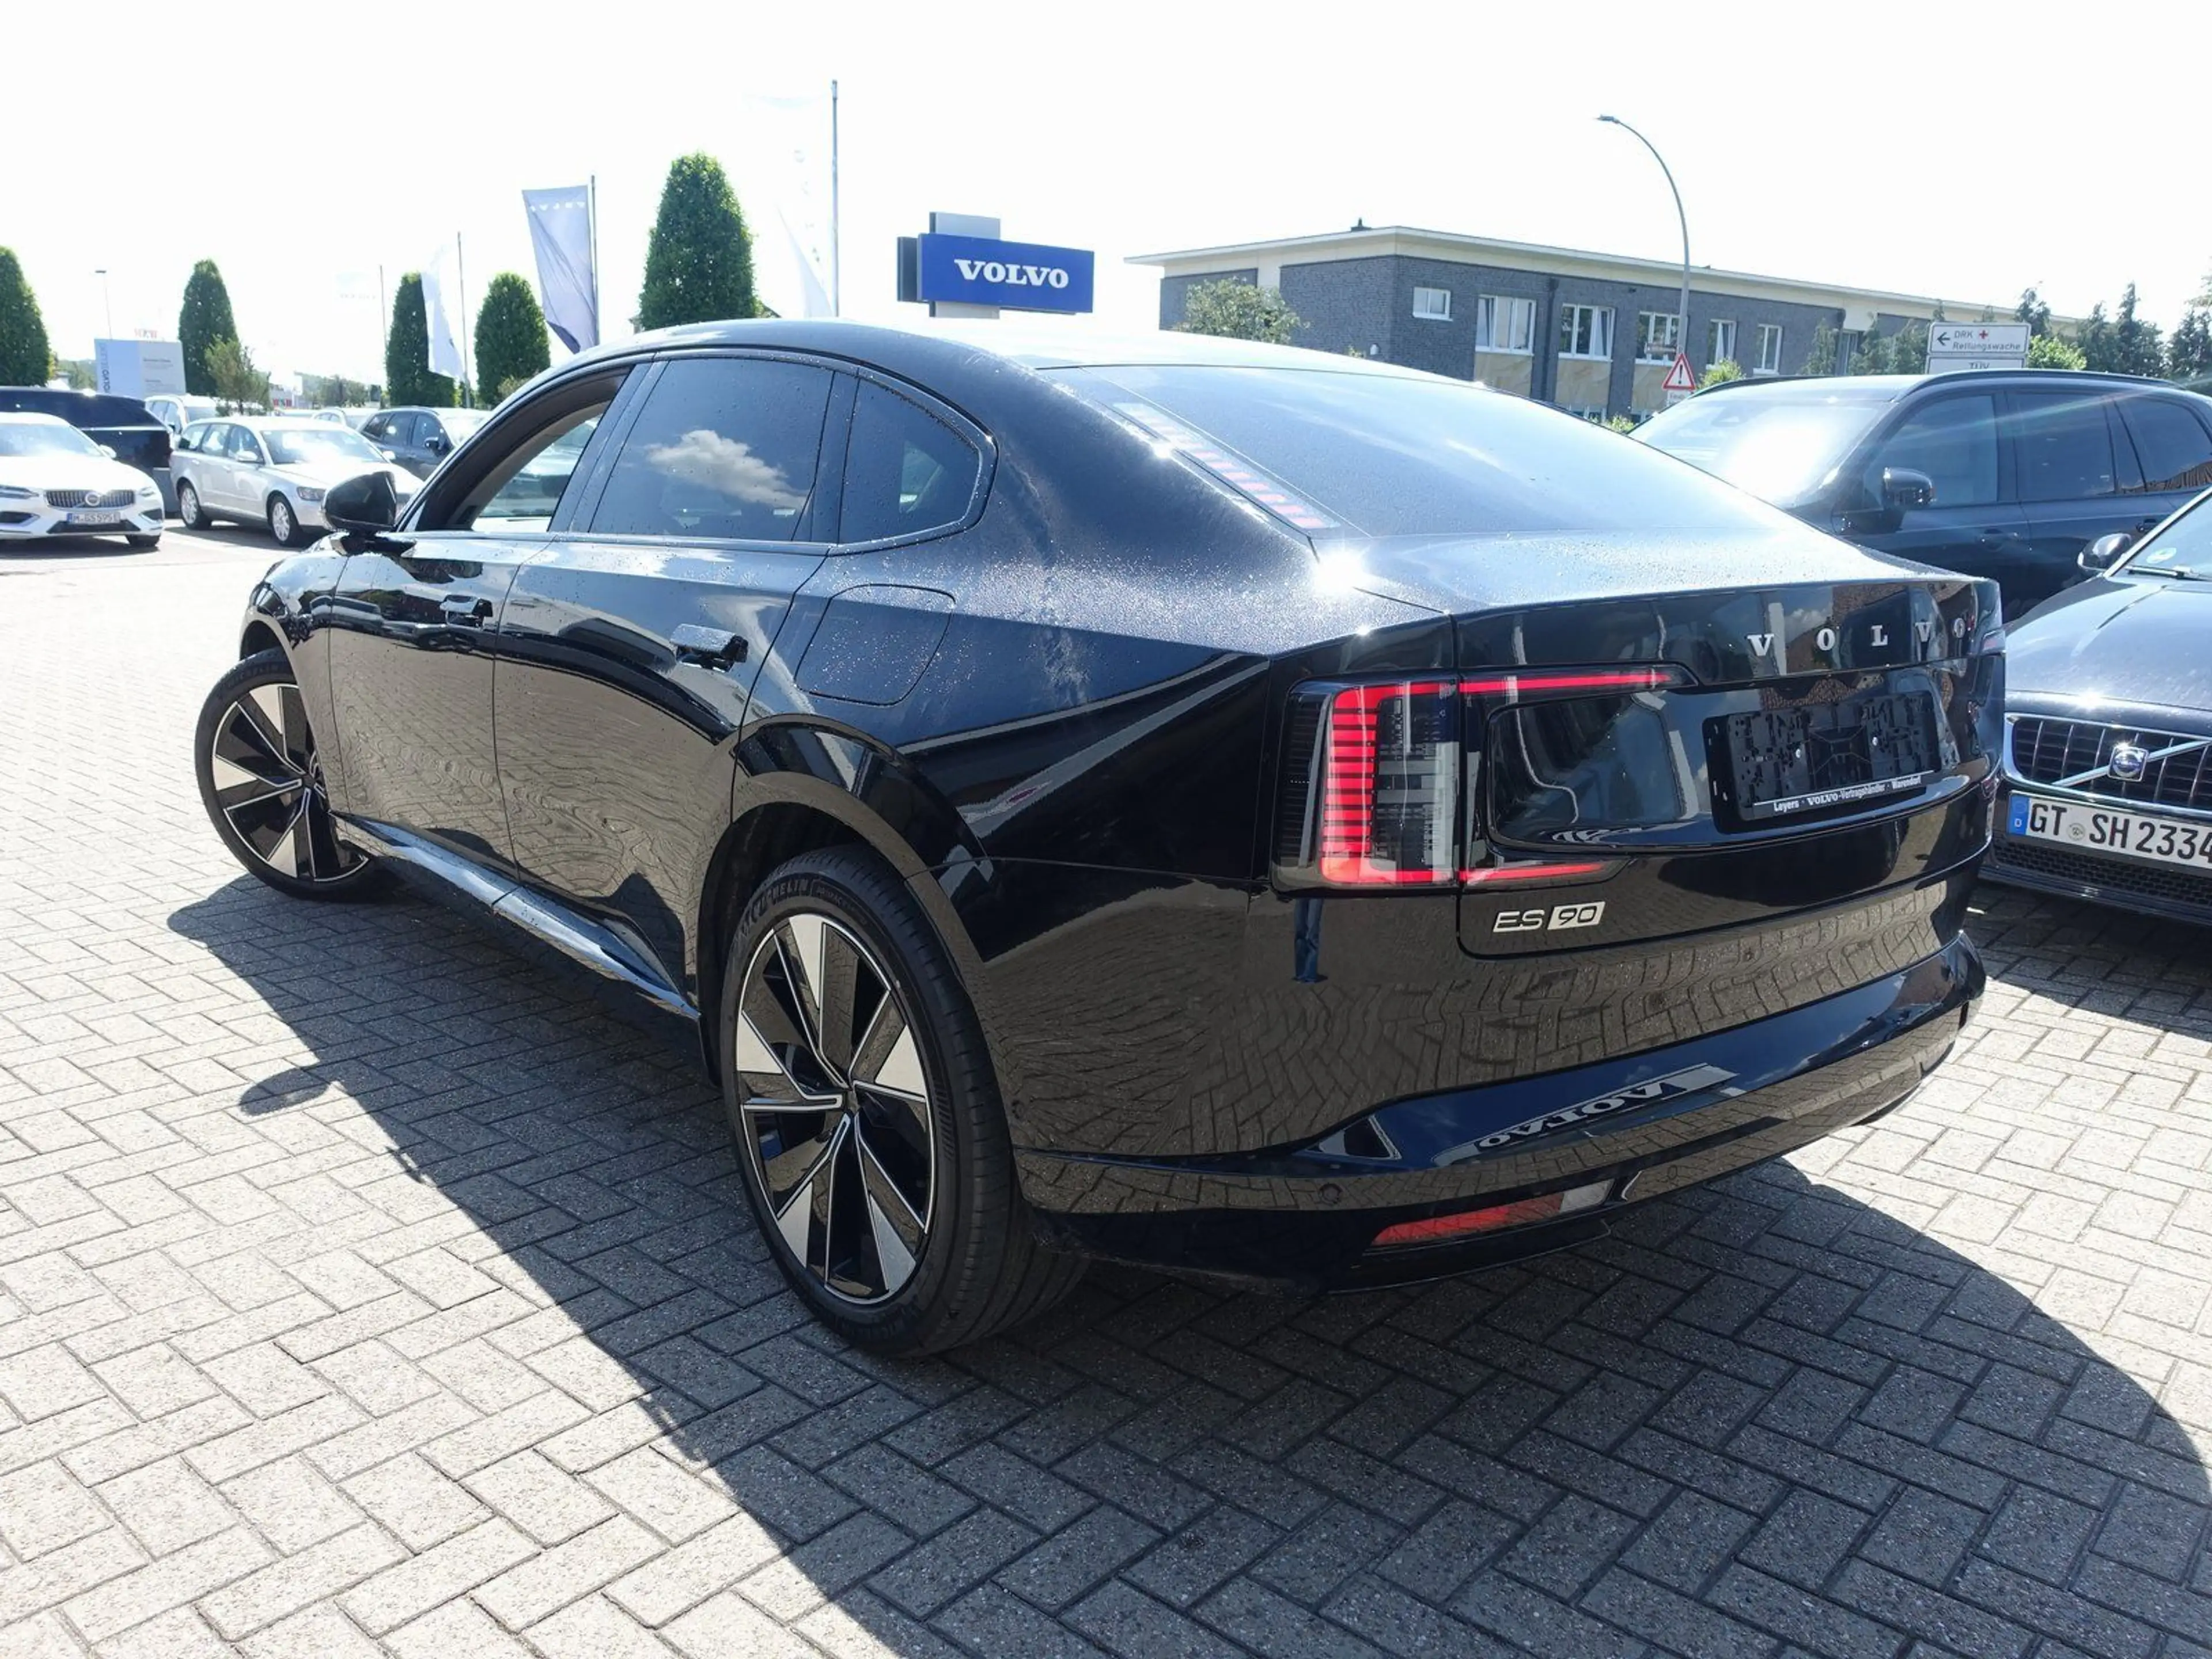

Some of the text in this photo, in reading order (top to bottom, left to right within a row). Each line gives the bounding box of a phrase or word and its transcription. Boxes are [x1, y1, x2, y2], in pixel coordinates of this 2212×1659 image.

[953, 258, 1069, 289] VOLVO
[1952, 342, 2021, 353] Rettungswache
[1953, 330, 1974, 339] DRK
[1747, 617, 1965, 657] VOLVO
[2029, 802, 2067, 836] GT
[2089, 813, 2130, 849] SH
[1493, 904, 1601, 933] ES 90
